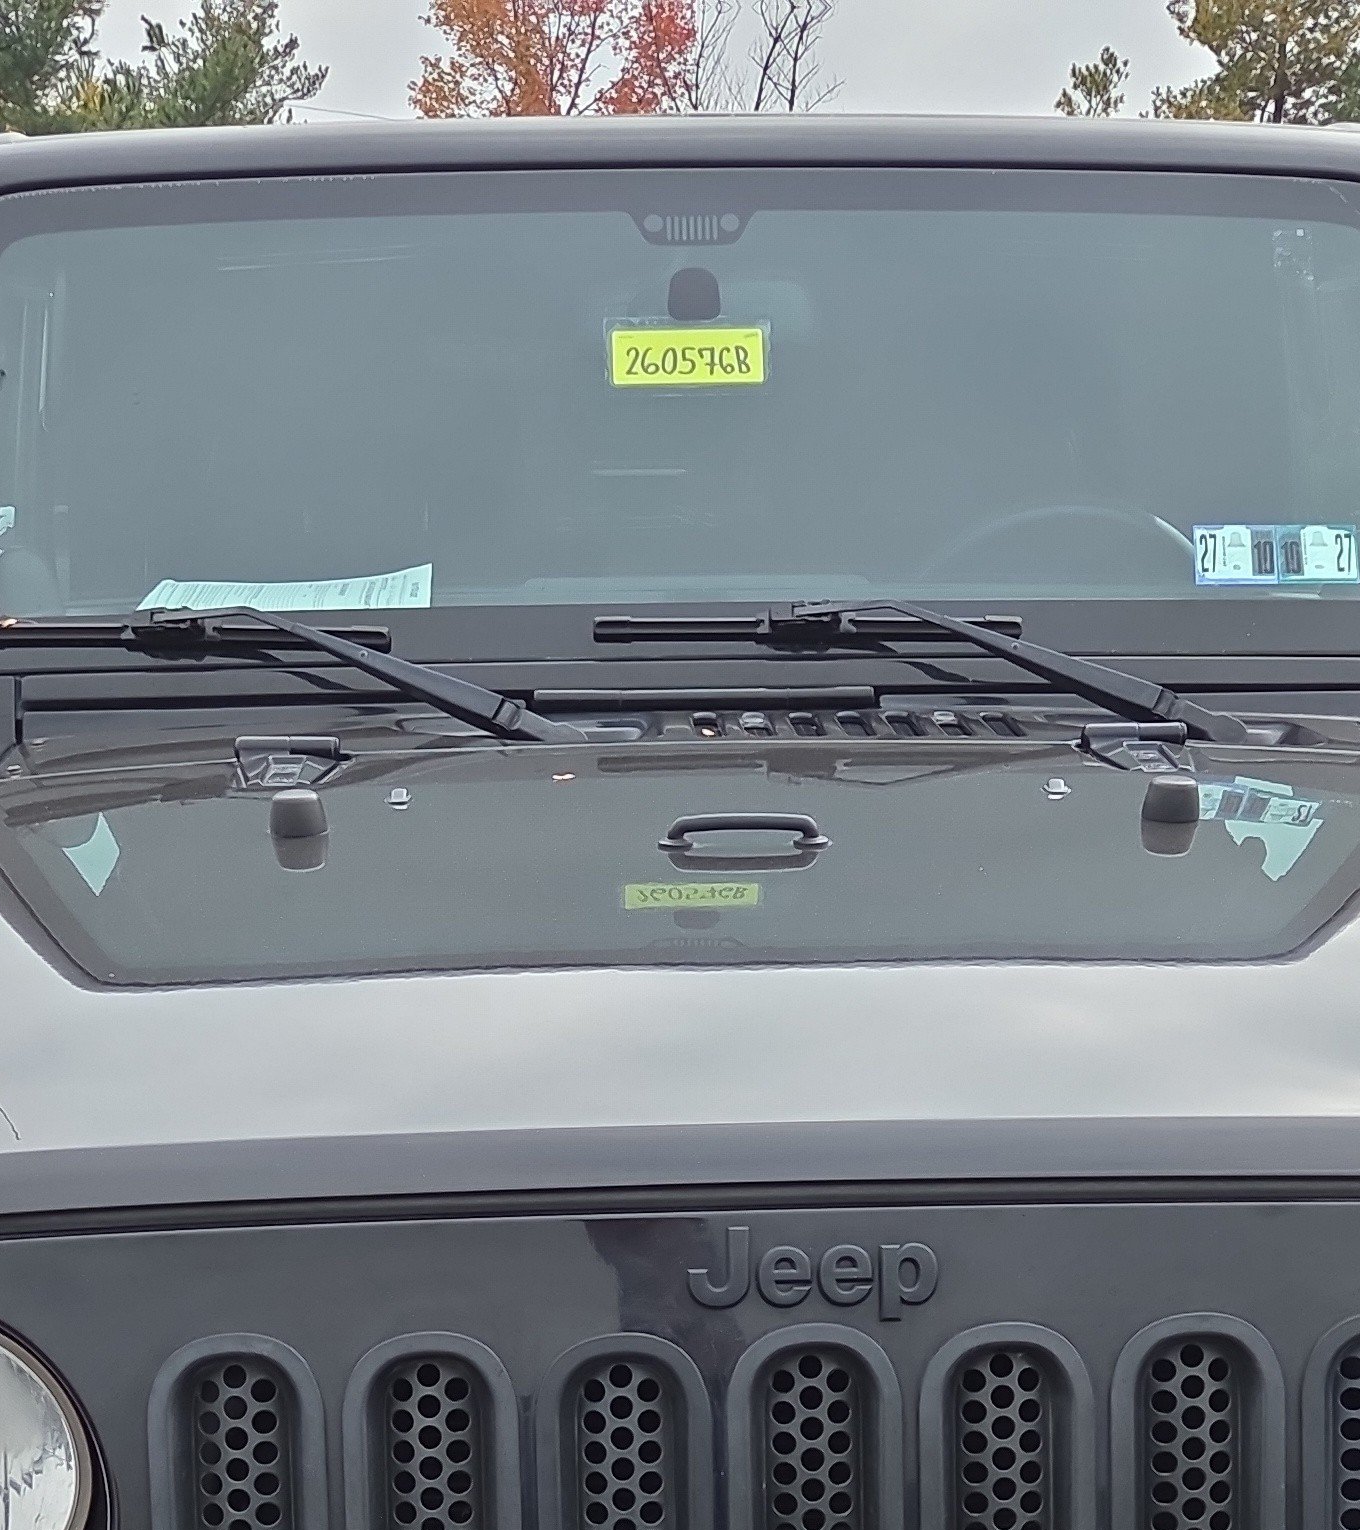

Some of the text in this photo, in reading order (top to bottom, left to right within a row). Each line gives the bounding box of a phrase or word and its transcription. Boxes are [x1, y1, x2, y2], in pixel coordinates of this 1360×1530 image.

[1199, 533, 1217, 573] 27
[1335, 533, 1352, 574] 27
[687, 1226, 939, 1321] Jeep
